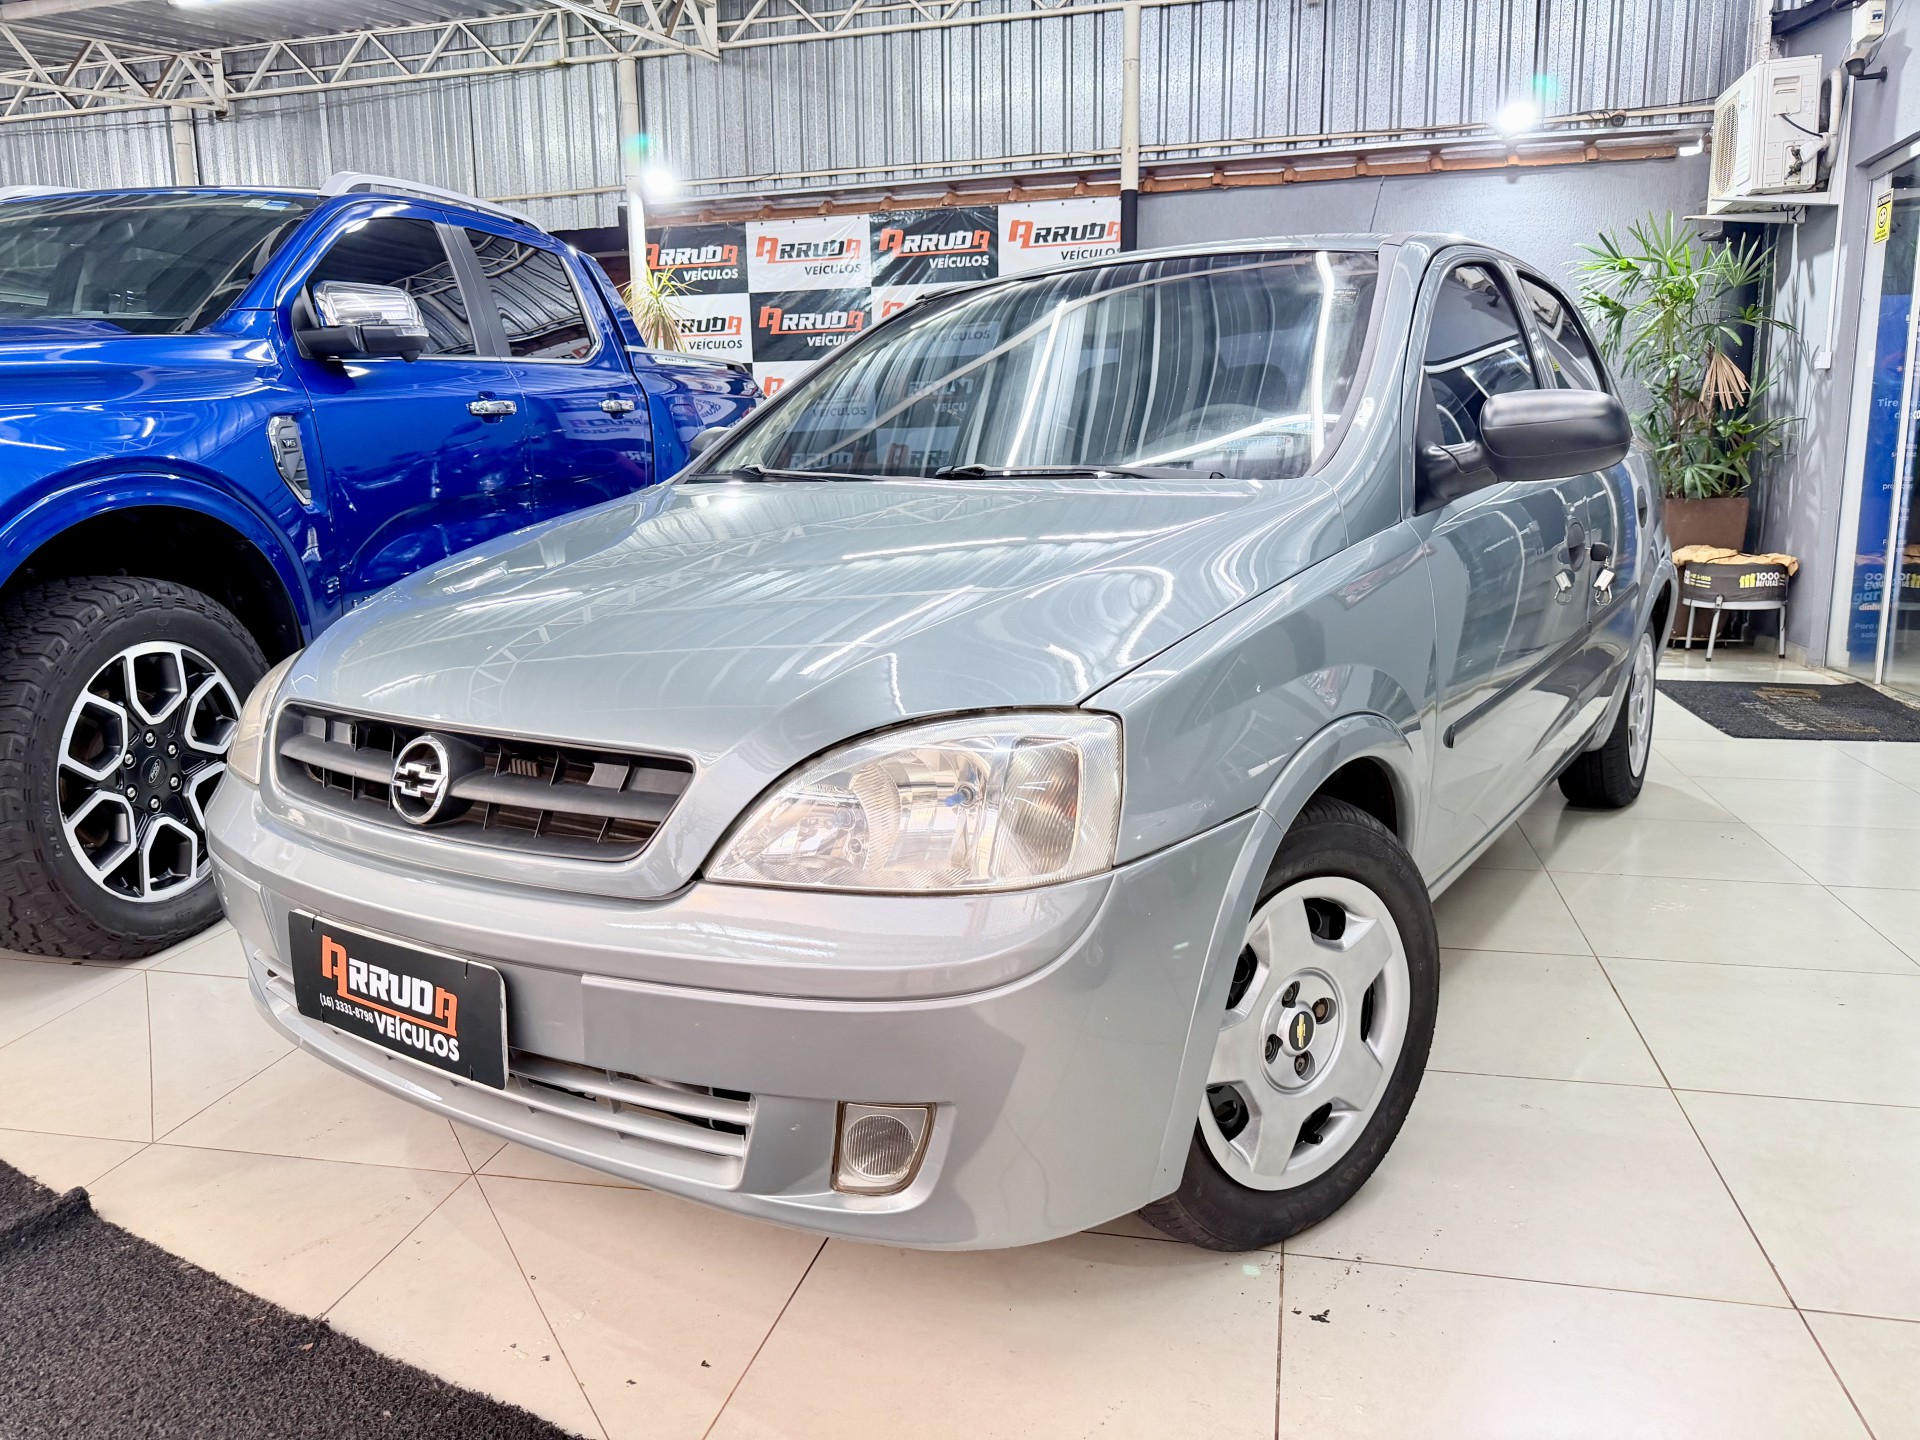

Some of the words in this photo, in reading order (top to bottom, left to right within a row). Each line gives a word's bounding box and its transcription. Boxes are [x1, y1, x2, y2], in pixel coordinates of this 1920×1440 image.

[879, 228, 991, 257] ARRUDA
[1008, 220, 1121, 249] ARRUDA
[646, 243, 739, 270] ARRUDA
[755, 236, 861, 264] ARRUDA
[929, 255, 990, 269] VEÍCULOS
[683, 268, 739, 281] VEÍCULOS
[804, 263, 862, 276] VEÍCULOS
[758, 306, 865, 335] ARRUDA
[689, 338, 743, 350] VEÍCULOS
[322, 935, 458, 1037] ARRUDA
[319, 993, 334, 1011] (16)
[334, 999, 374, 1024] 3331-8798
[374, 1011, 460, 1062] VEÍCULOS
